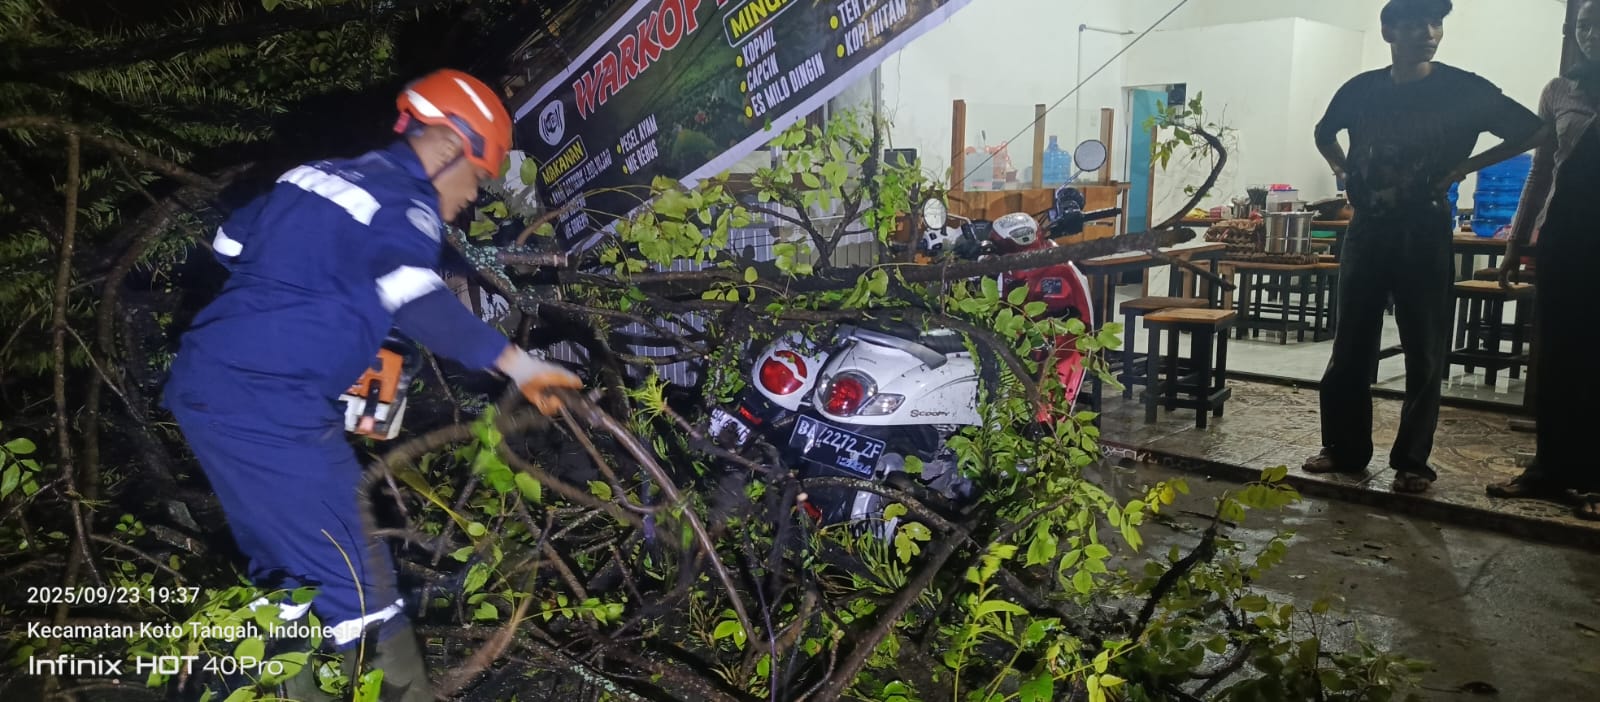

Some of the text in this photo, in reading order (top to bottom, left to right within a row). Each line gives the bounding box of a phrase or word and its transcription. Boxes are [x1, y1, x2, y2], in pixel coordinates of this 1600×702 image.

[836, 0, 861, 27] TEH
[844, 0, 907, 57] KOPI HITAM
[572, 0, 701, 120] WARKOP
[742, 26, 777, 67] KOPMIL
[746, 52, 779, 92] CAPCIN
[751, 52, 826, 117] ES MILO DINGIN
[620, 113, 658, 154] PECEL AYAM
[541, 141, 584, 185] MAKANAN
[625, 138, 659, 174] MIE REBUS
[862, 441, 882, 458] ZF
